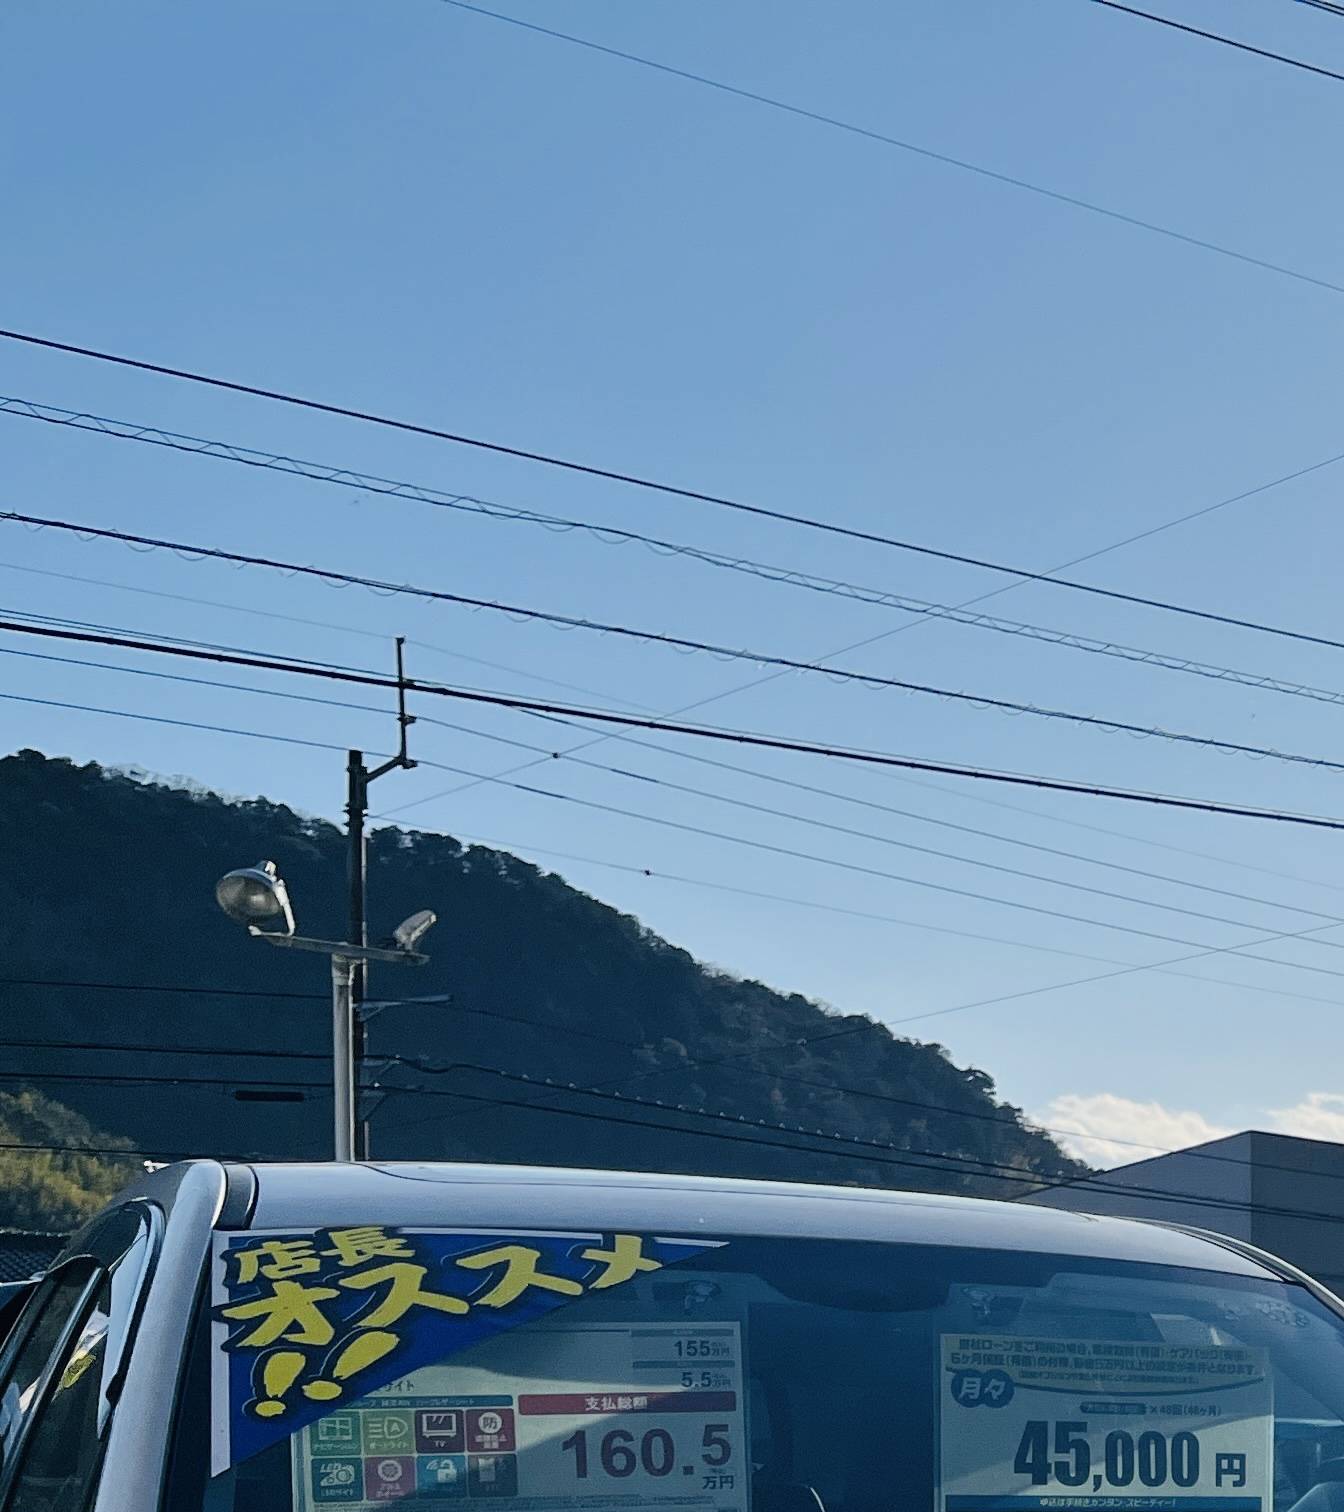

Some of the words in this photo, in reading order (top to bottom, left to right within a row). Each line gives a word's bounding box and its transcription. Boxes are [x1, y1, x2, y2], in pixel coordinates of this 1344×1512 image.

[234, 1227, 415, 1283] 店長
[959, 1377, 1007, 1401] 月々
[562, 1424, 732, 1479] 160.5
[1014, 1420, 1200, 1492] 45,000
[1214, 1453, 1247, 1488] 円
[702, 1475, 735, 1490] 万円
